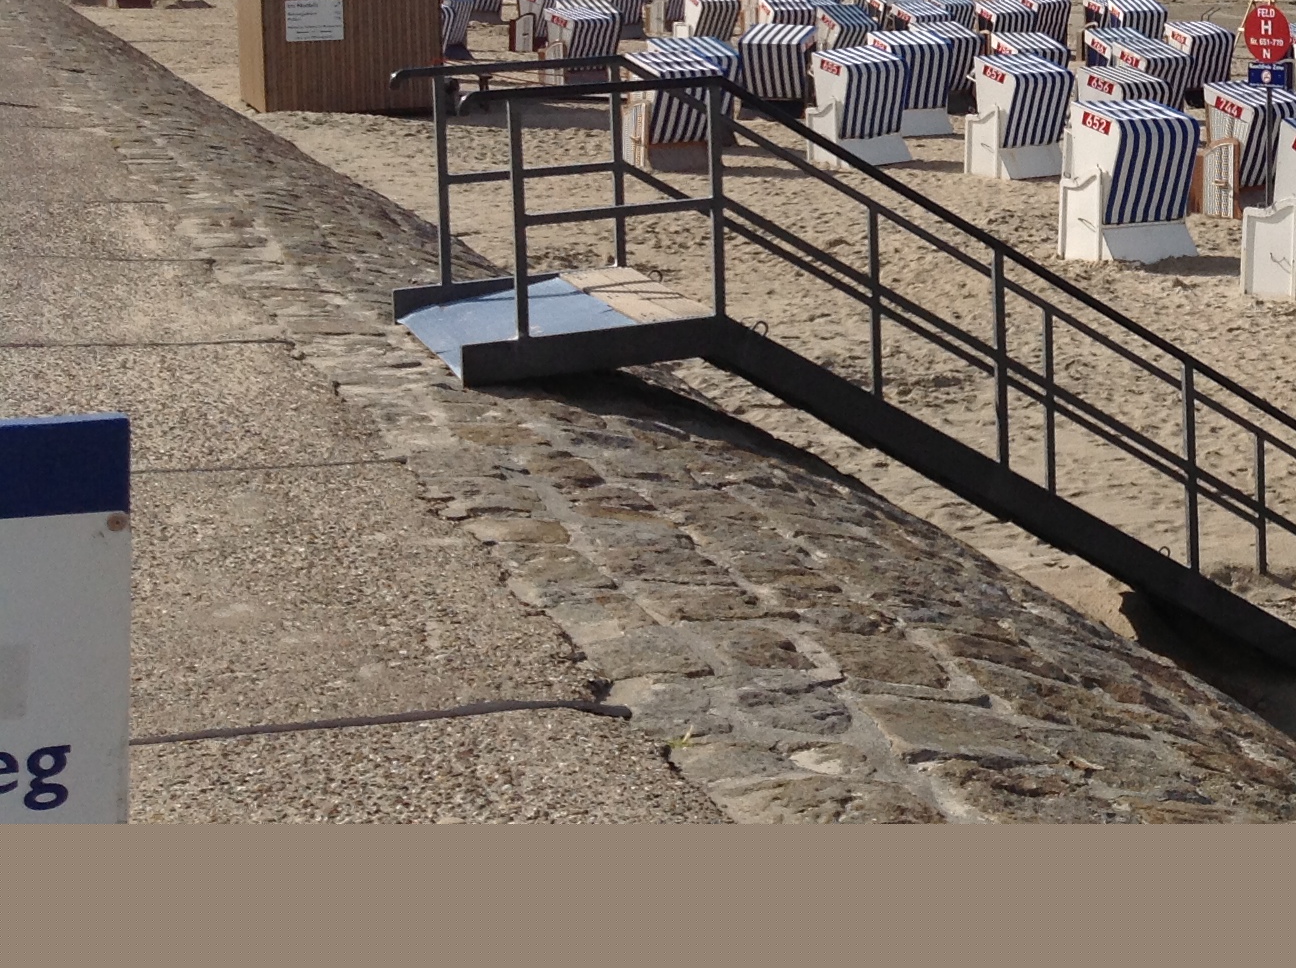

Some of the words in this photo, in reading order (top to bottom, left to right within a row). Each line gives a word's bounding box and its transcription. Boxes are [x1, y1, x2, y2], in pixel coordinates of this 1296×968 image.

[1257, 7, 1276, 18] FELD
[1261, 19, 1272, 35] H
[1262, 48, 1271, 59] N
[985, 68, 1003, 82] 657
[1091, 76, 1110, 93] 656
[1218, 98, 1238, 116] 744
[1086, 113, 1107, 134] 652
